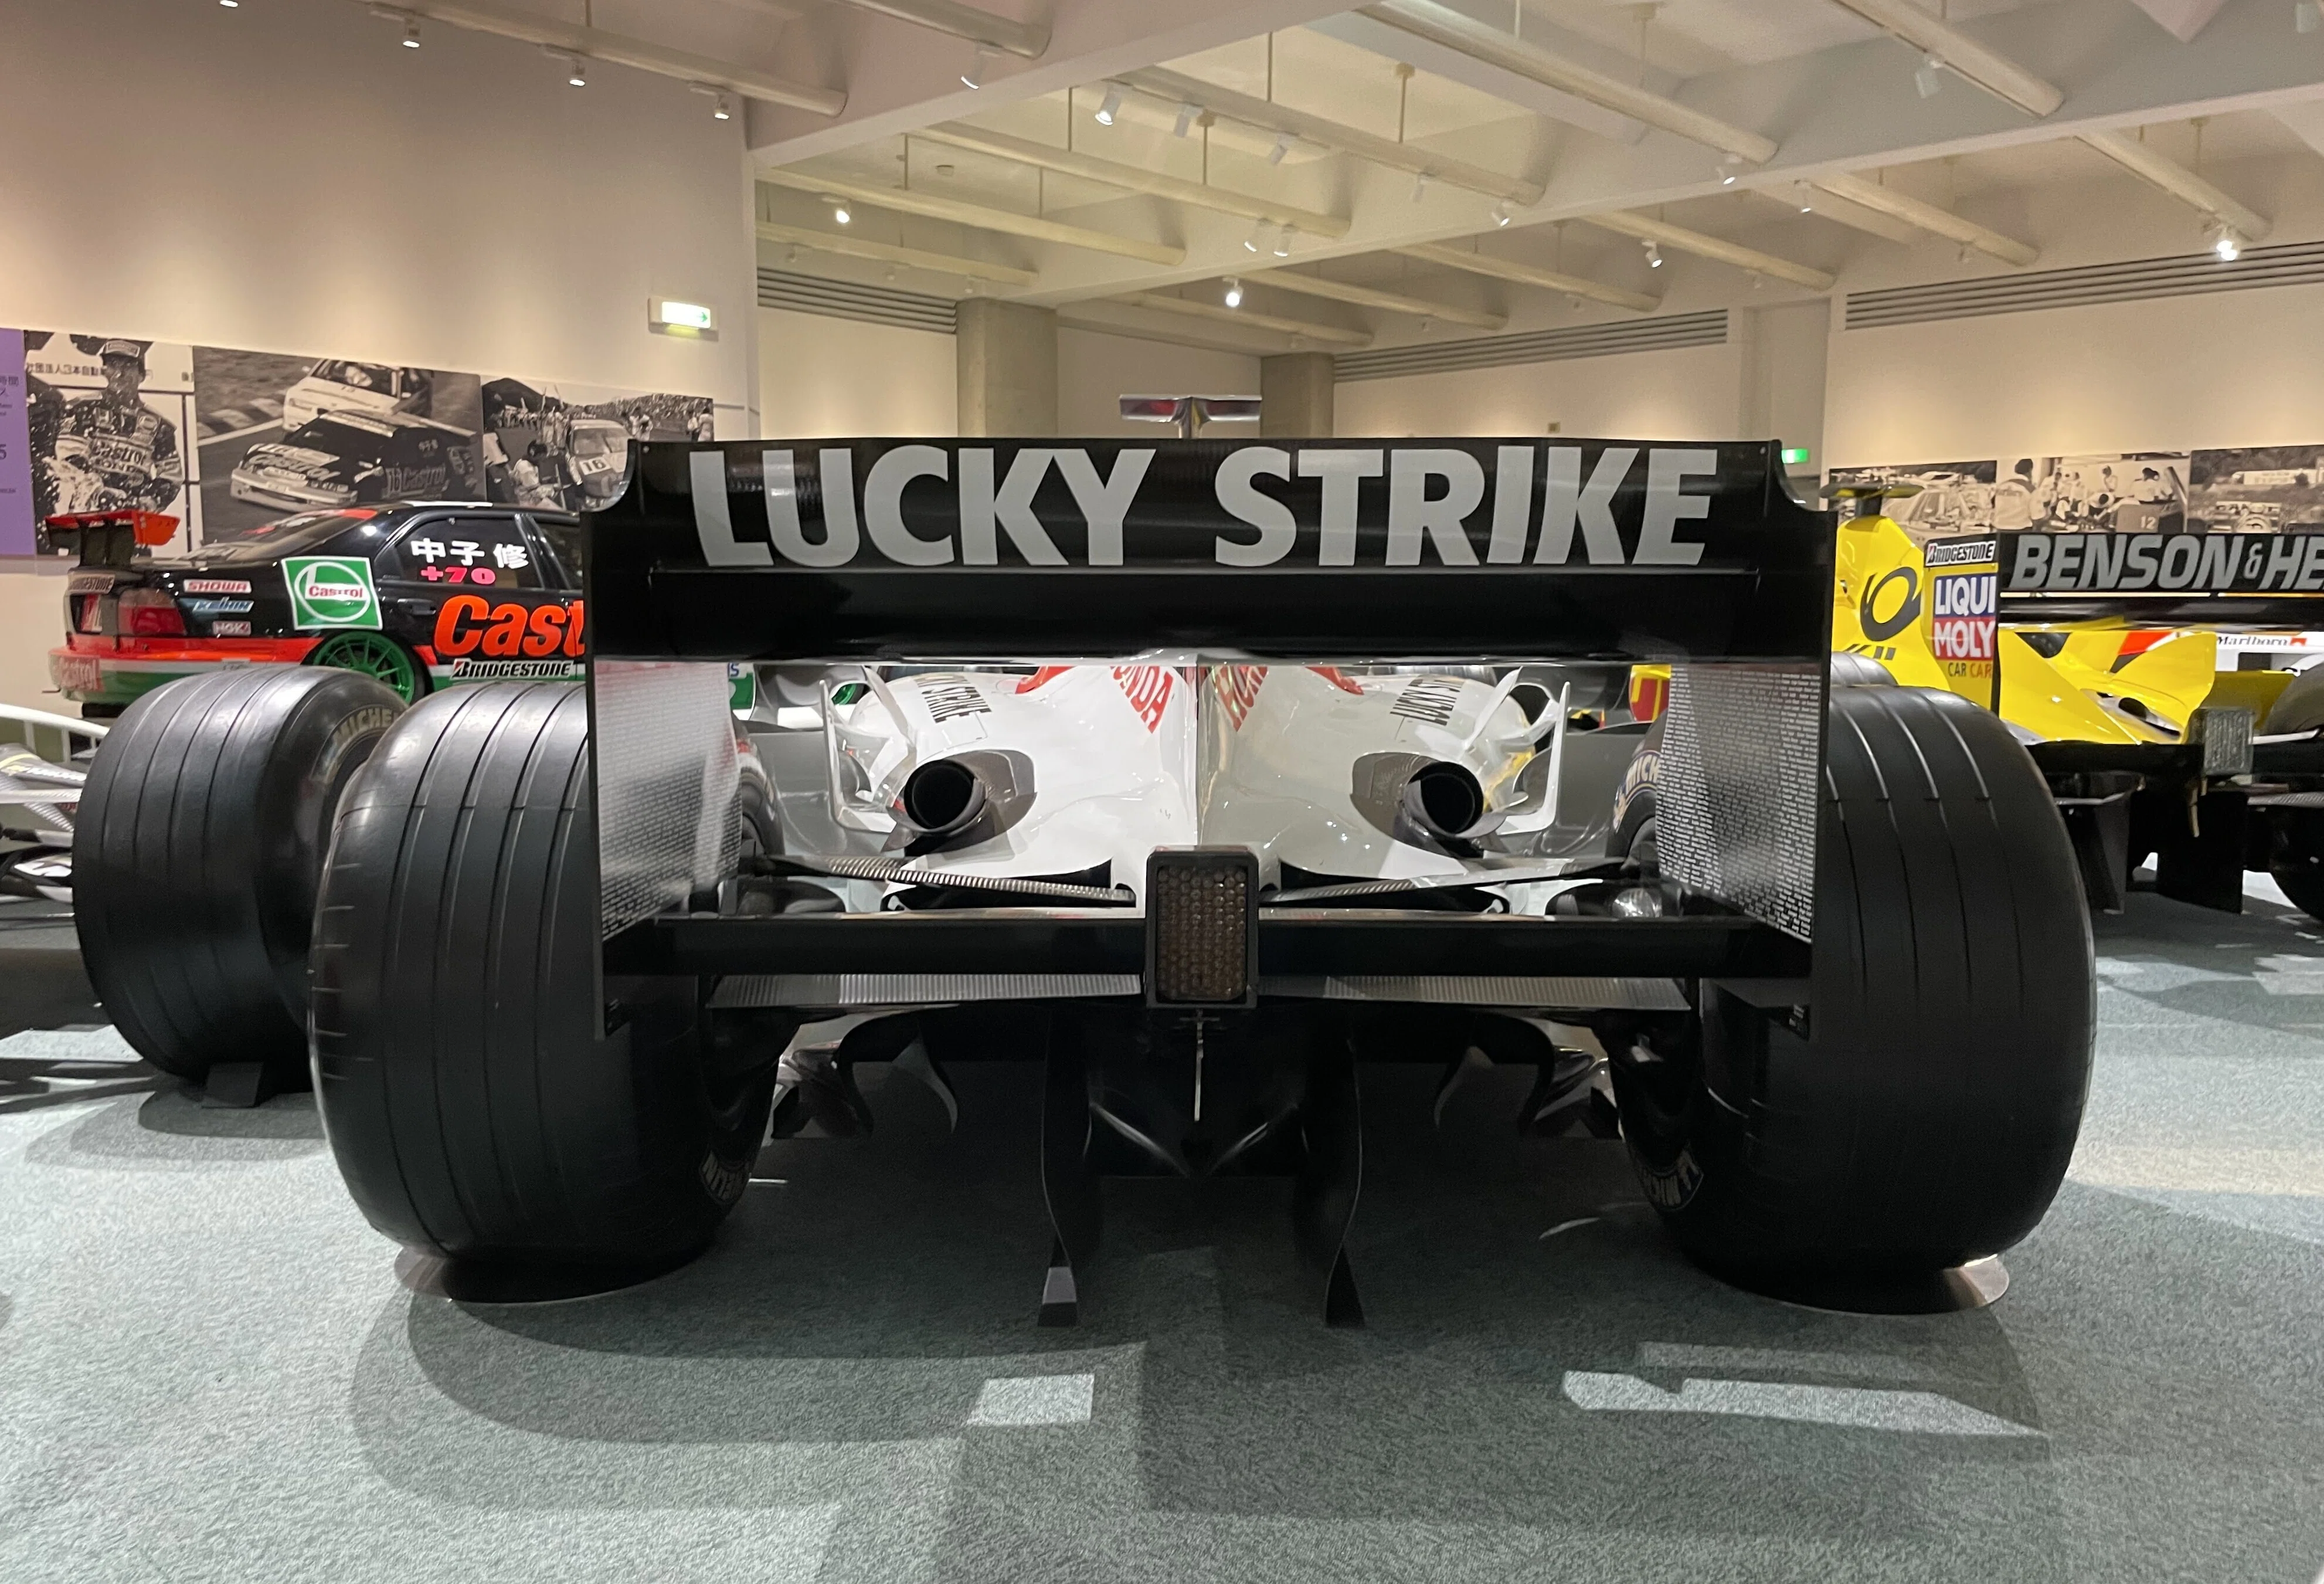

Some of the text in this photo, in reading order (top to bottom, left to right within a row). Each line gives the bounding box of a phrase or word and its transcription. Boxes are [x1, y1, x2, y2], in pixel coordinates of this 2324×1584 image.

[582, 460, 606, 472] 16
[689, 445, 1718, 567] LUCKY STRIKE
[2141, 516, 2157, 528] 12
[1927, 544, 1995, 564] BRIDGESTONE
[2009, 534, 2245, 589] BENSON
[2244, 542, 2262, 579] &
[189, 581, 247, 591] SHOWA
[309, 586, 363, 598] Castrol
[1935, 576, 1997, 617] LIQUI
[1935, 620, 1996, 658] MOLY
[2217, 636, 2288, 646] Marlboro
[454, 659, 571, 678] BRIDGESTONE
[1948, 662, 1967, 677] CAR
